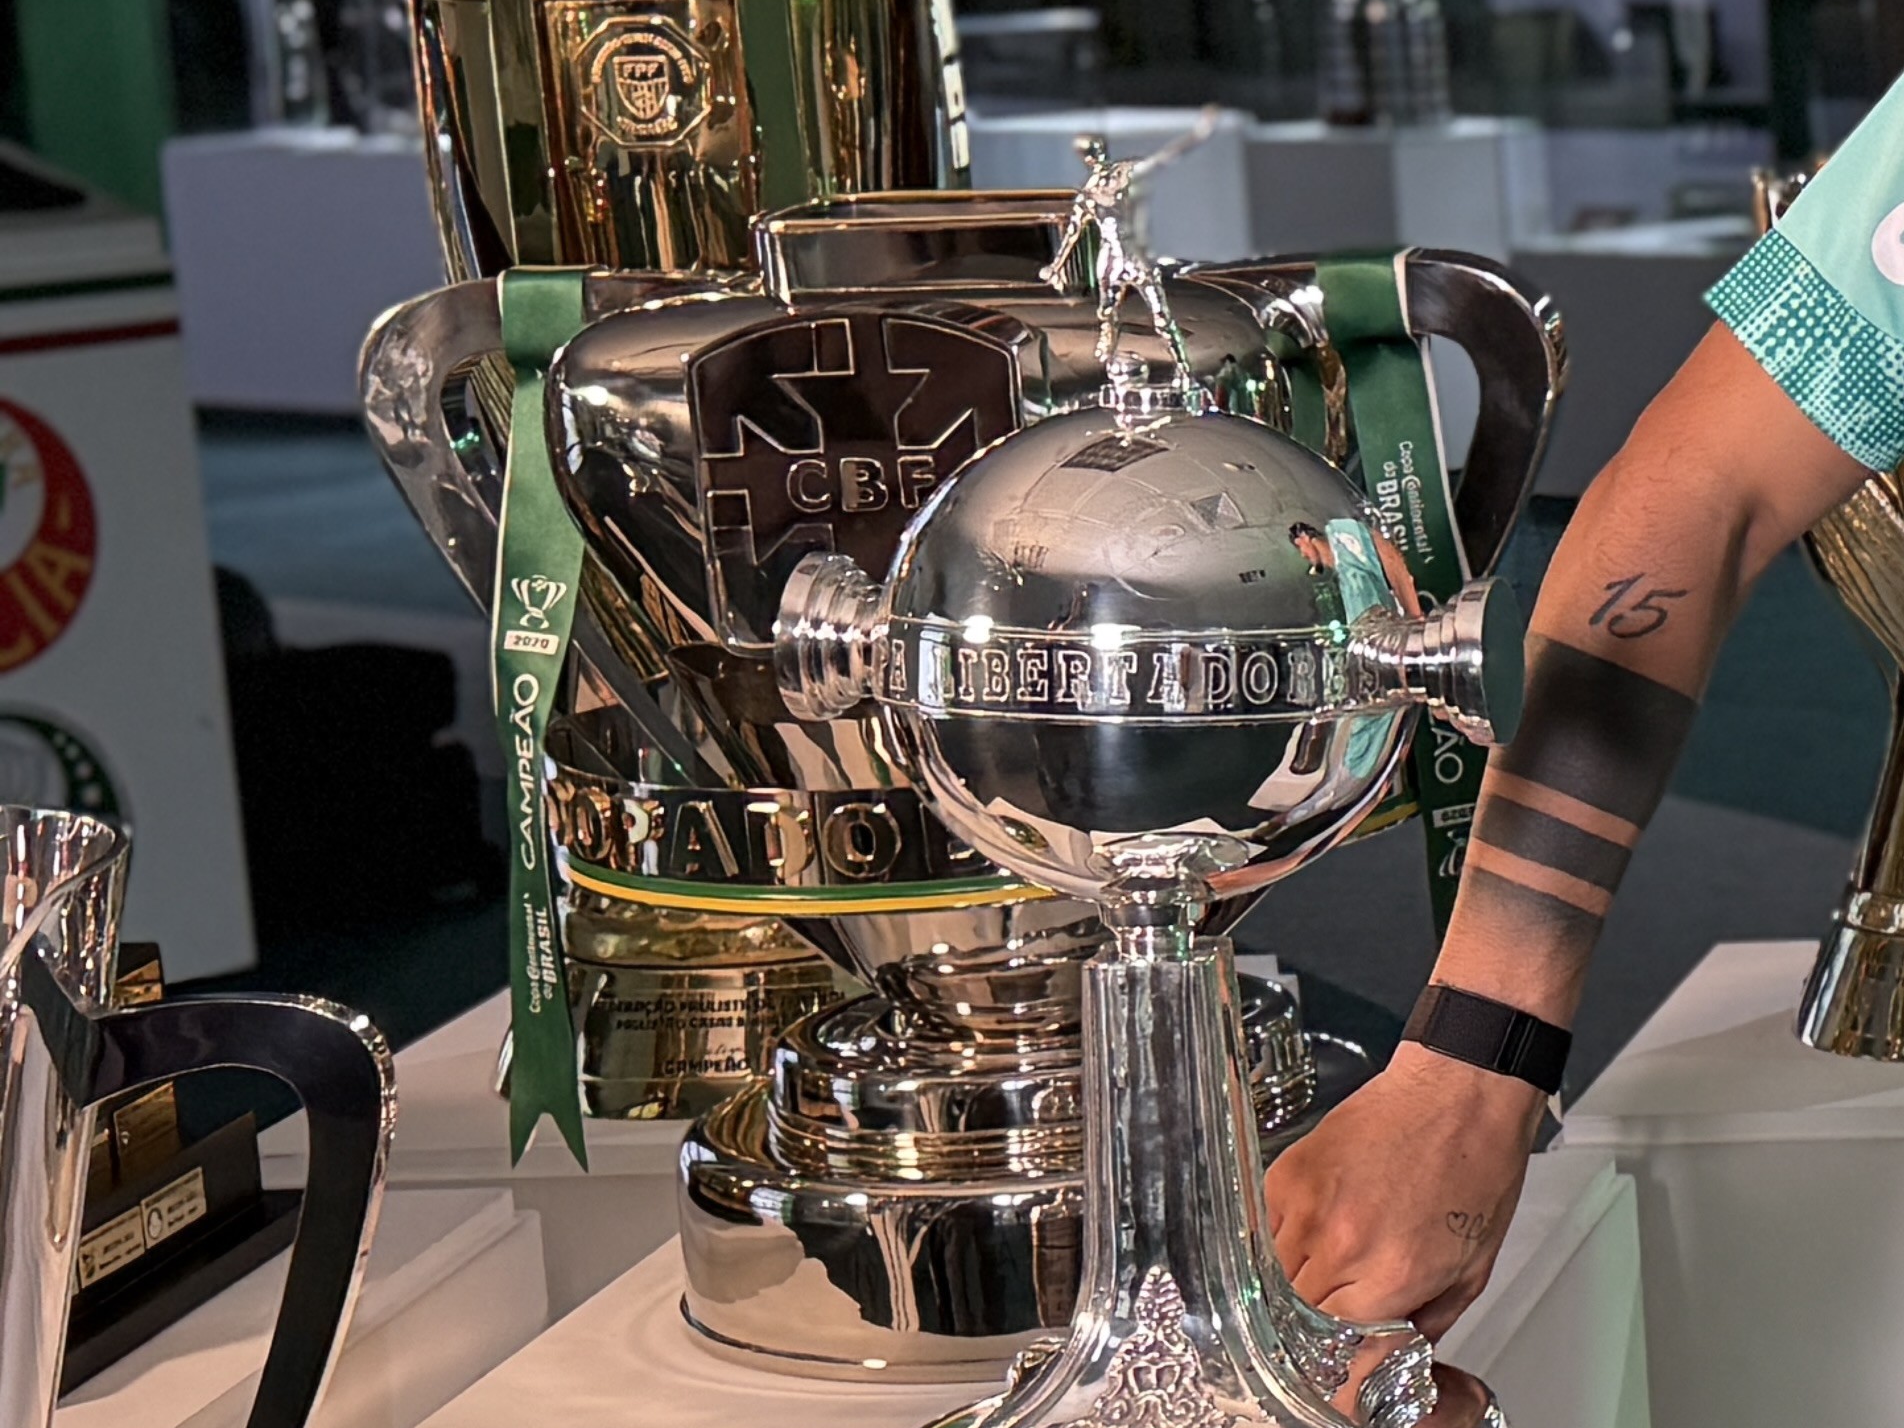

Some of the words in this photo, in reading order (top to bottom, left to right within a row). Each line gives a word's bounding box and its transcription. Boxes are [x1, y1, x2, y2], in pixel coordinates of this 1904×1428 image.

[786, 455, 937, 513] CBF
[1589, 572, 1692, 639] 15
[512, 673, 540, 871] CAMPEÃO
[536, 906, 557, 983] BRASIL
